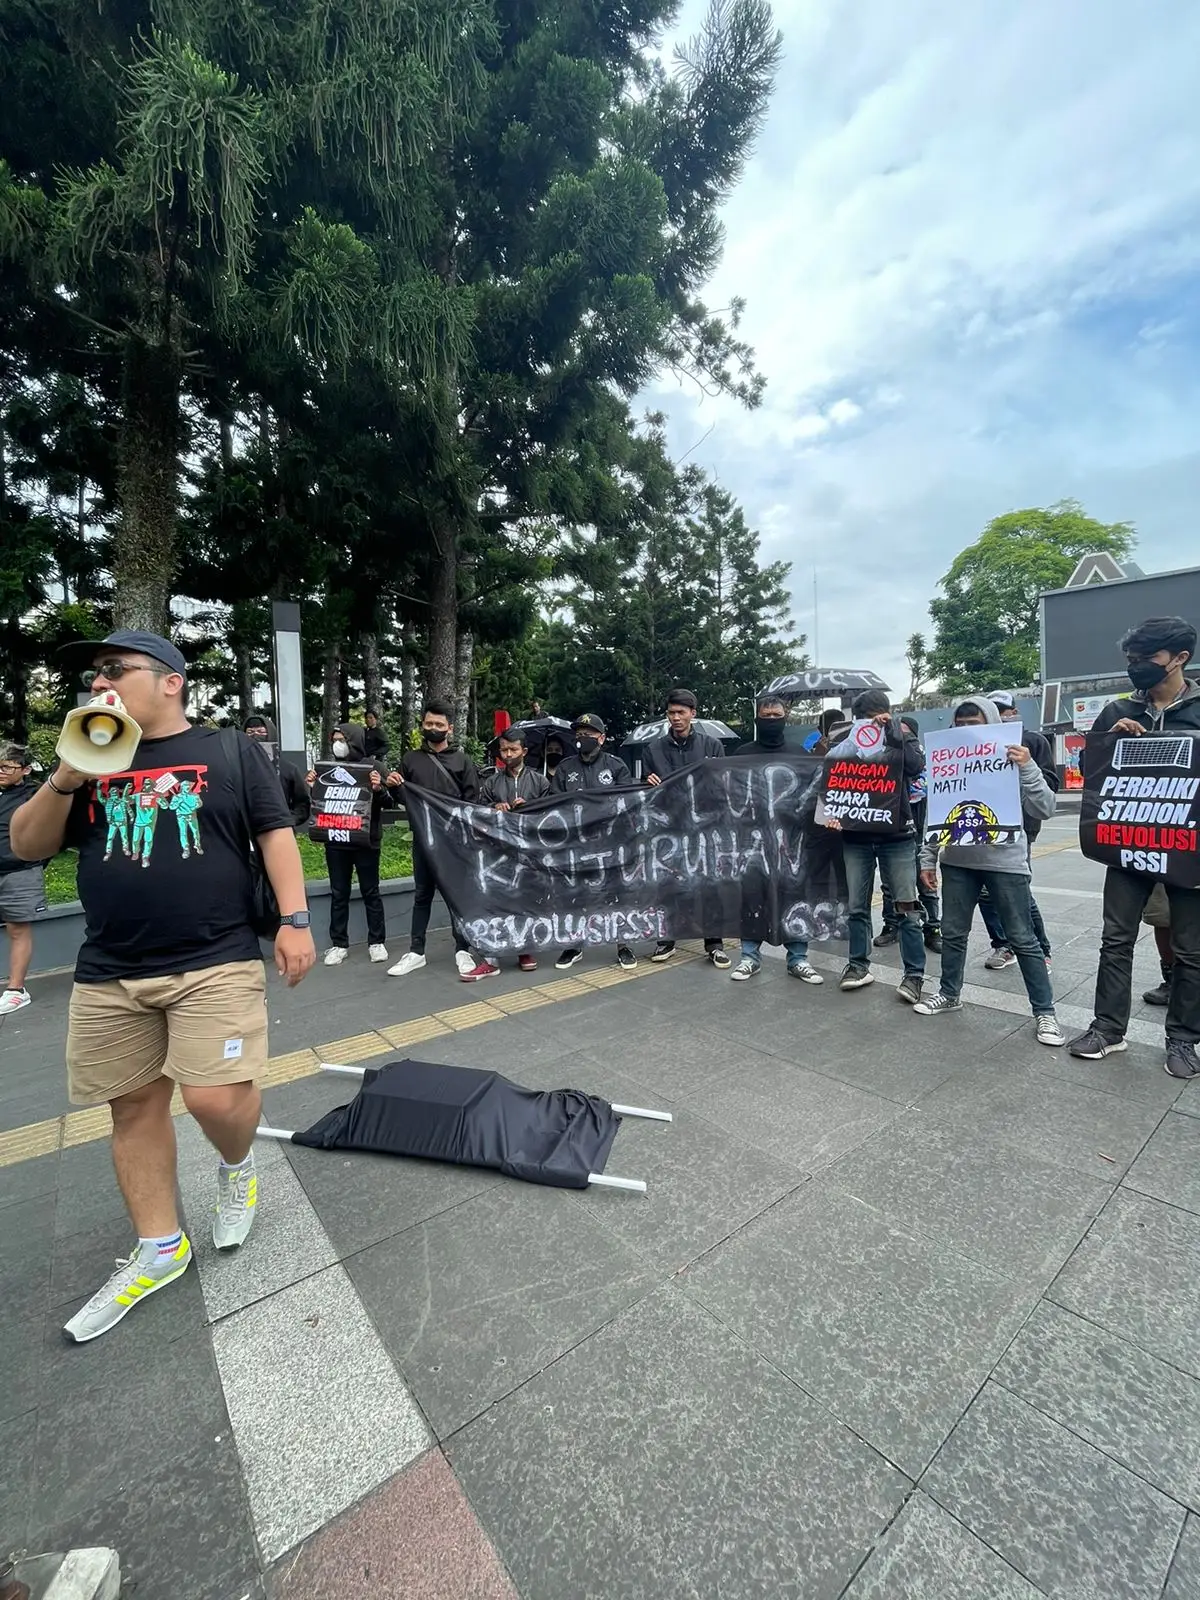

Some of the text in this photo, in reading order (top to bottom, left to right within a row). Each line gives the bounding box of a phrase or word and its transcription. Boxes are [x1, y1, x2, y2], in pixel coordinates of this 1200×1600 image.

[932, 743, 997, 763] REVOLUSI
[830, 762, 889, 777] JANGAN
[932, 759, 1013, 778] PSSI HARGA
[324, 786, 361, 800] BENAHI
[828, 776, 896, 793] BUNGKAM
[933, 778, 967, 794] MATI!
[1099, 776, 1200, 800] PERBAIKI
[825, 790, 870, 807] SUARA
[823, 803, 893, 825] SUPORTER
[1097, 800, 1196, 828] STADION,
[958, 819, 983, 829] PSSI
[328, 829, 350, 842] PSSI
[1096, 823, 1197, 851] REVOLUSI
[1120, 849, 1168, 874] PSSI
